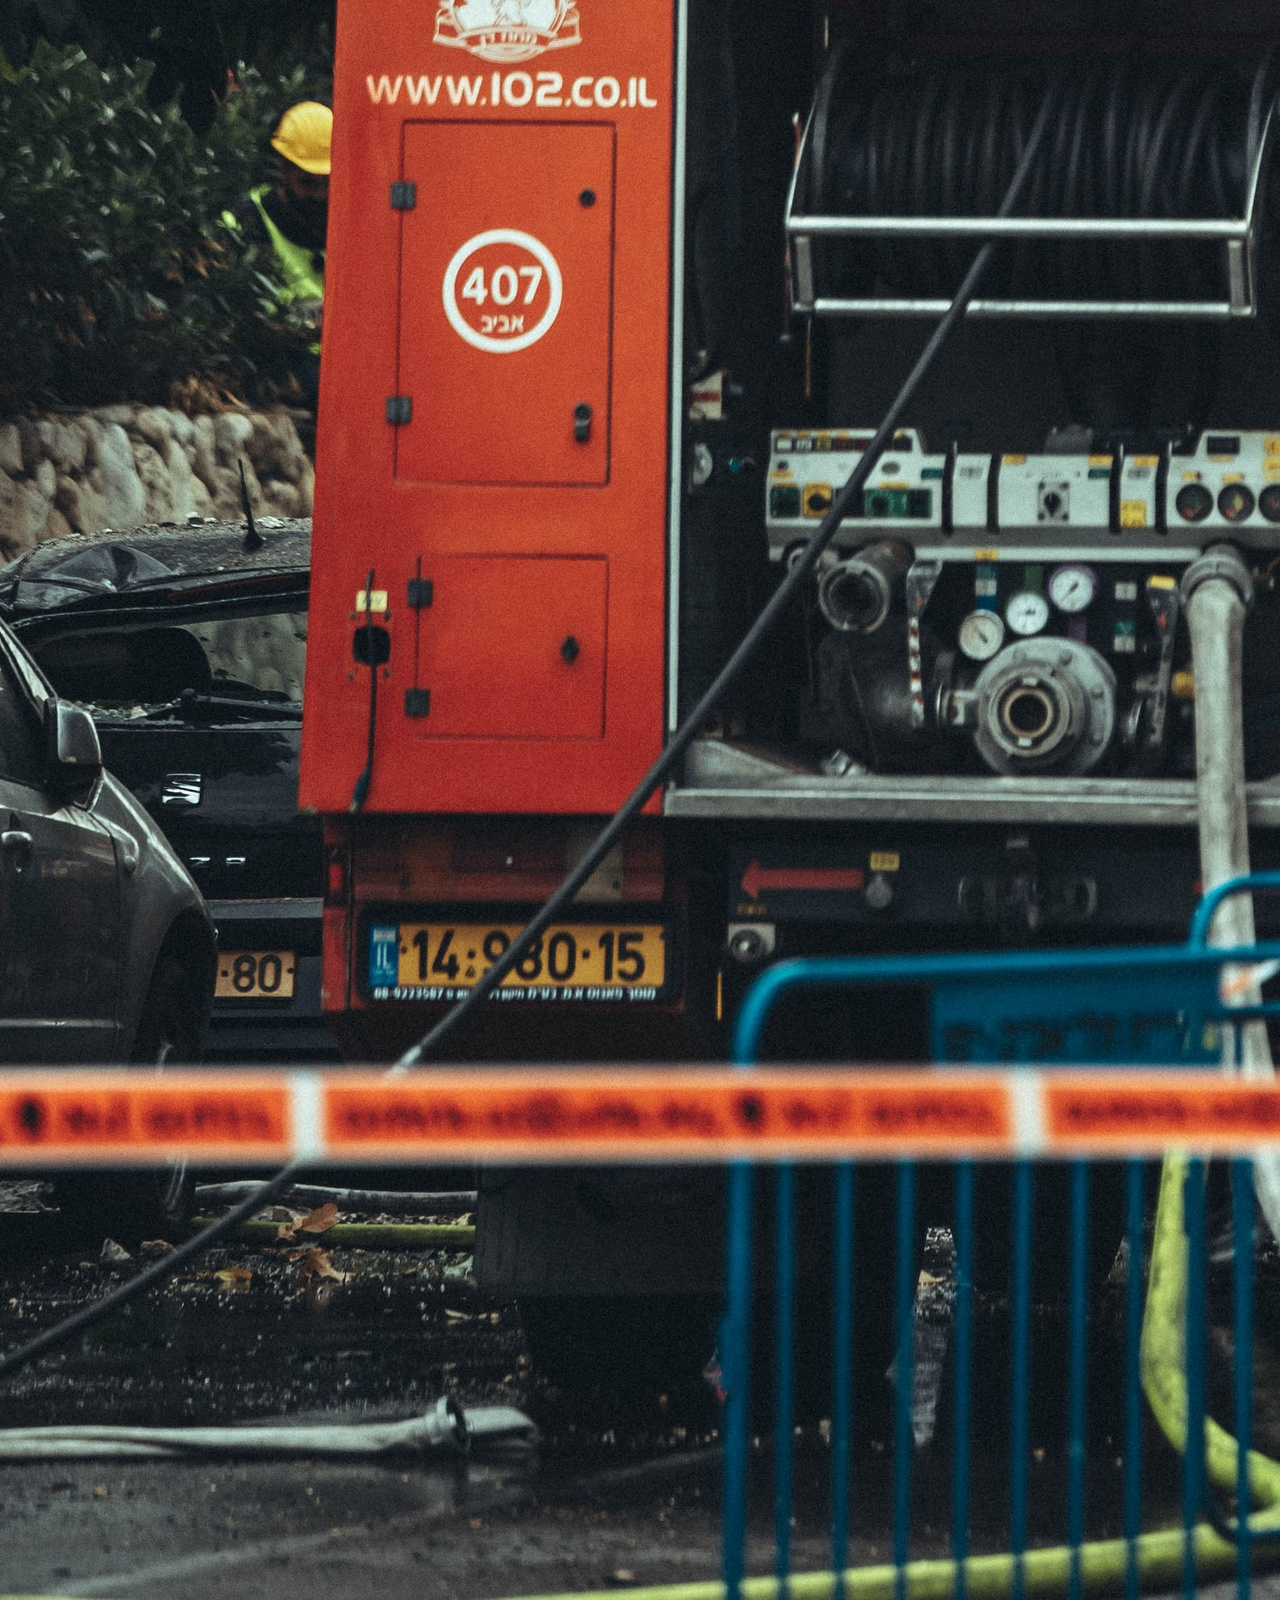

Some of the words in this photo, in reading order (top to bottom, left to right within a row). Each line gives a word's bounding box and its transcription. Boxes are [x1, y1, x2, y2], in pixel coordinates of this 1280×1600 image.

[462, 265, 542, 306] 407
[481, 314, 525, 334] אביב
[377, 943, 392, 970] IL
